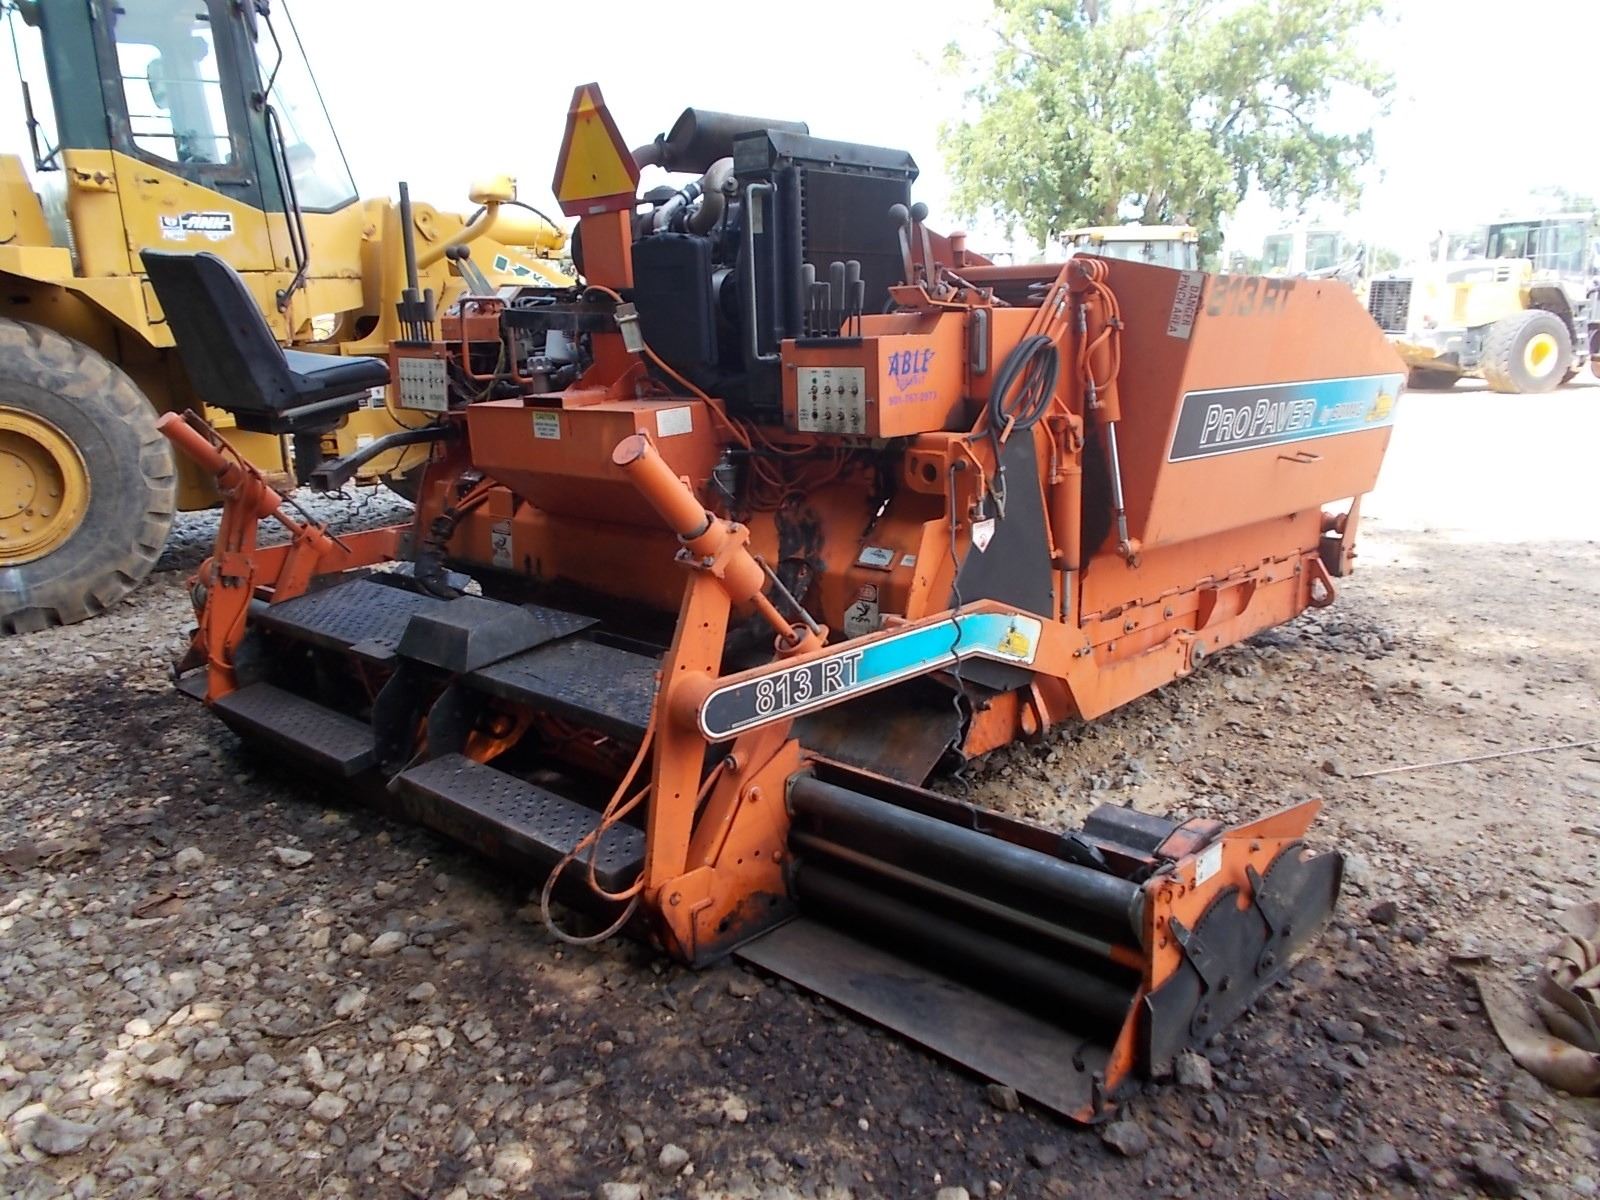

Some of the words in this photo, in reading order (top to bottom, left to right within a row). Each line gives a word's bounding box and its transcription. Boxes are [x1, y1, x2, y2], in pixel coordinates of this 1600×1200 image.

[1175, 274, 1190, 305] PINCH
[1168, 307, 1182, 332] AREA
[1181, 286, 1199, 325] DANGER
[888, 348, 932, 375] ABLE
[756, 668, 813, 715] 813
[821, 652, 864, 697] RT
